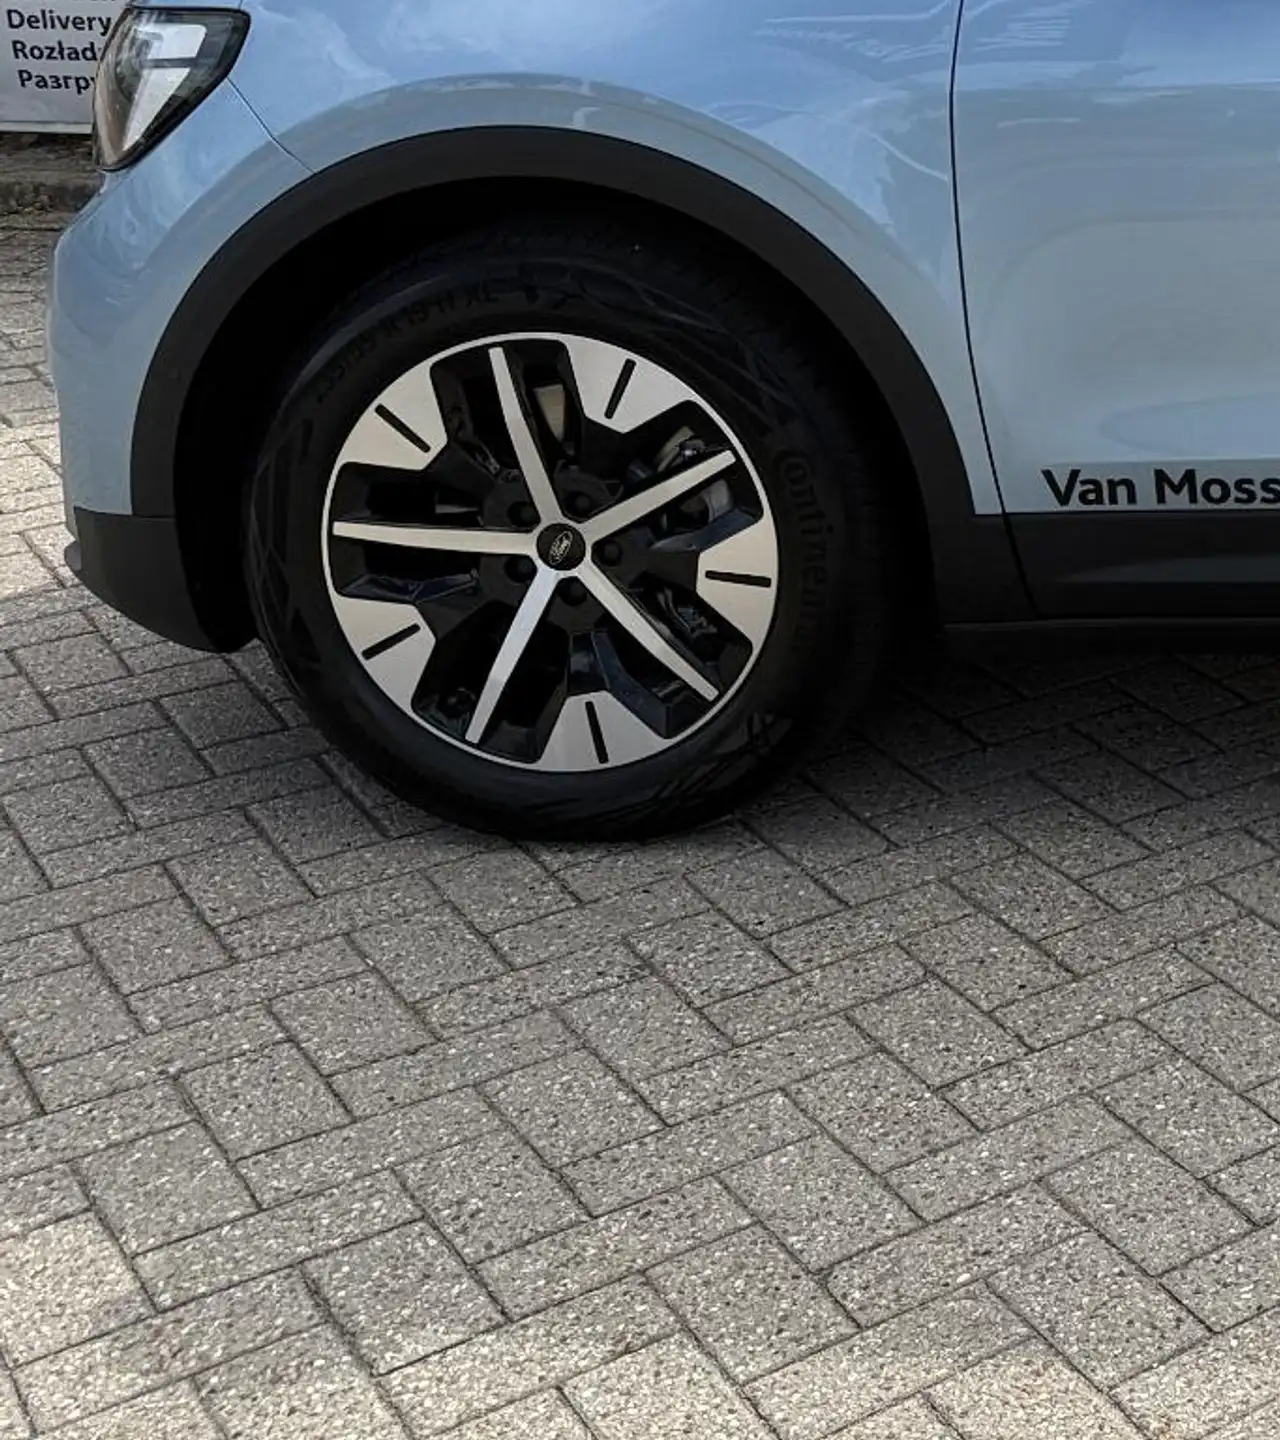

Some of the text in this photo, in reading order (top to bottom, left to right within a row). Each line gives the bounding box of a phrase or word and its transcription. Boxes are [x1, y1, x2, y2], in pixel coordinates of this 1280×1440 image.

[6, 9, 112, 37] Delivery
[11, 39, 101, 62] Rozład
[17, 69, 96, 96] Разгр
[1041, 468, 1138, 507] Van
